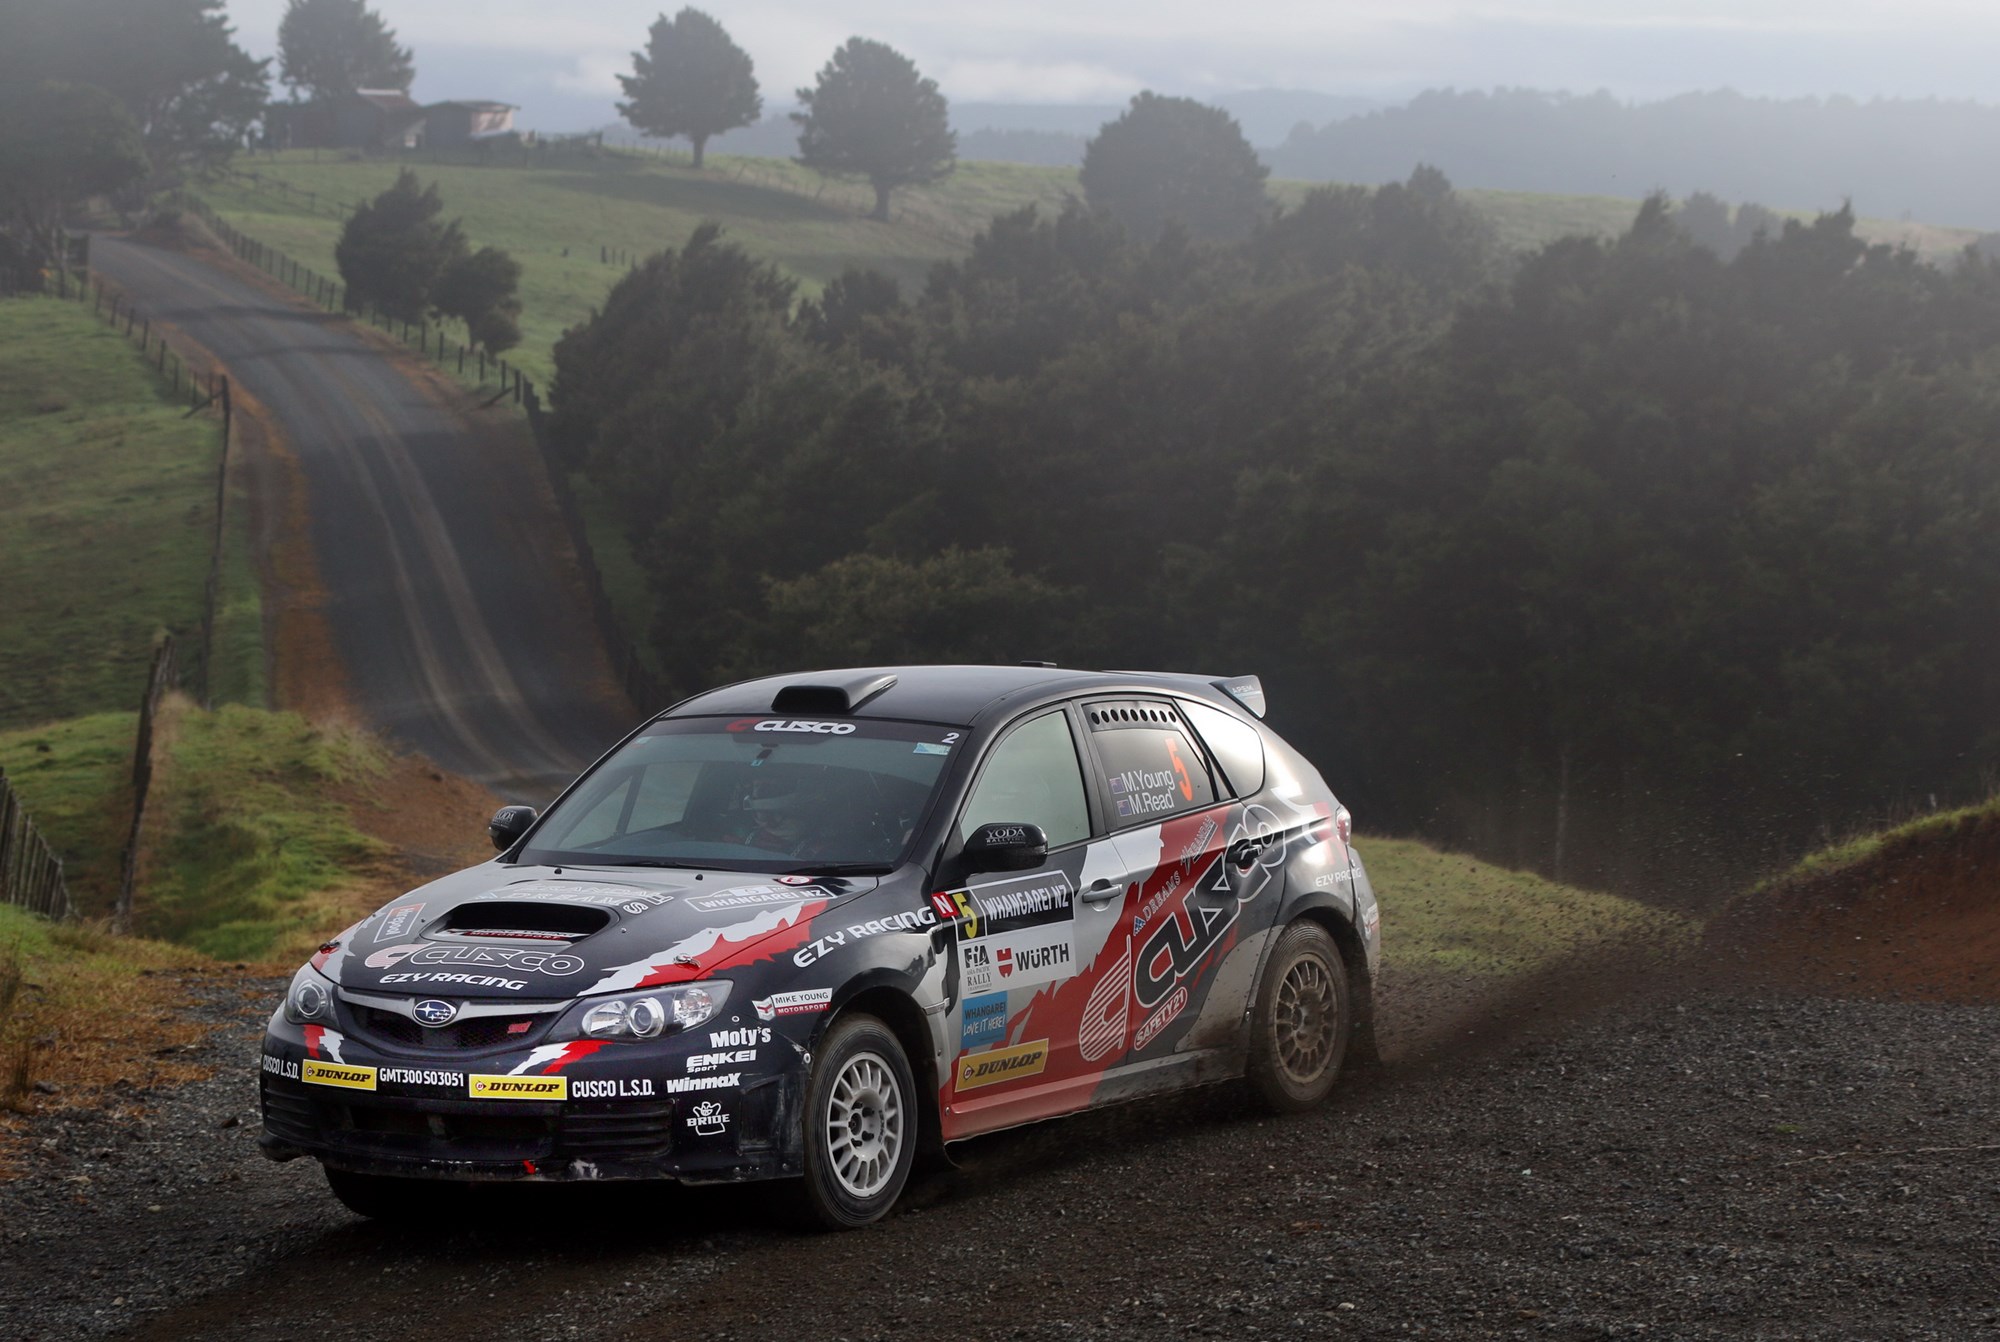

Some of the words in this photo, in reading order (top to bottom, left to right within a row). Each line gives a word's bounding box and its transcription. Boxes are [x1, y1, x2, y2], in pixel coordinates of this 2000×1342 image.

[754, 720, 856, 735] CUSCO
[942, 732, 960, 744] 2
[1164, 737, 1193, 802] 5
[1120, 769, 1176, 793] M.Young
[1128, 788, 1175, 815] M.Read
[986, 828, 1026, 839] YODA
[1315, 873, 1335, 887] EZY
[699, 893, 799, 909] WHANGAREI
[800, 888, 827, 899] NZ
[1143, 870, 1182, 922] DREAMS
[952, 892, 978, 939] 5
[981, 886, 1051, 921] WHANGAREI
[1050, 884, 1069, 909] NZ
[792, 930, 847, 968] EZY
[846, 905, 937, 939] RACING
[410, 945, 585, 977] CUSCO
[379, 973, 432, 985] EZY
[435, 973, 528, 990] RACING
[967, 971, 992, 986] RALLY
[775, 994, 797, 1004] MIKE
[798, 991, 829, 1001] YOUNG
[777, 1003, 828, 1014] MOTORSPORT
[964, 1001, 1007, 1020] WHANGAREI
[709, 1026, 772, 1049] Moty's
[686, 1049, 757, 1068] ENKEI
[975, 1051, 1043, 1077] DUNLOP
[280, 1060, 300, 1080] L.S.D.
[316, 1068, 371, 1083] DUNLOP
[686, 1064, 718, 1074] Sport
[488, 1082, 560, 1093] DUNLOP
[572, 1080, 616, 1098] CUSCO
[620, 1079, 655, 1097] L.S.D.
[686, 1113, 731, 1127] BRIDE
